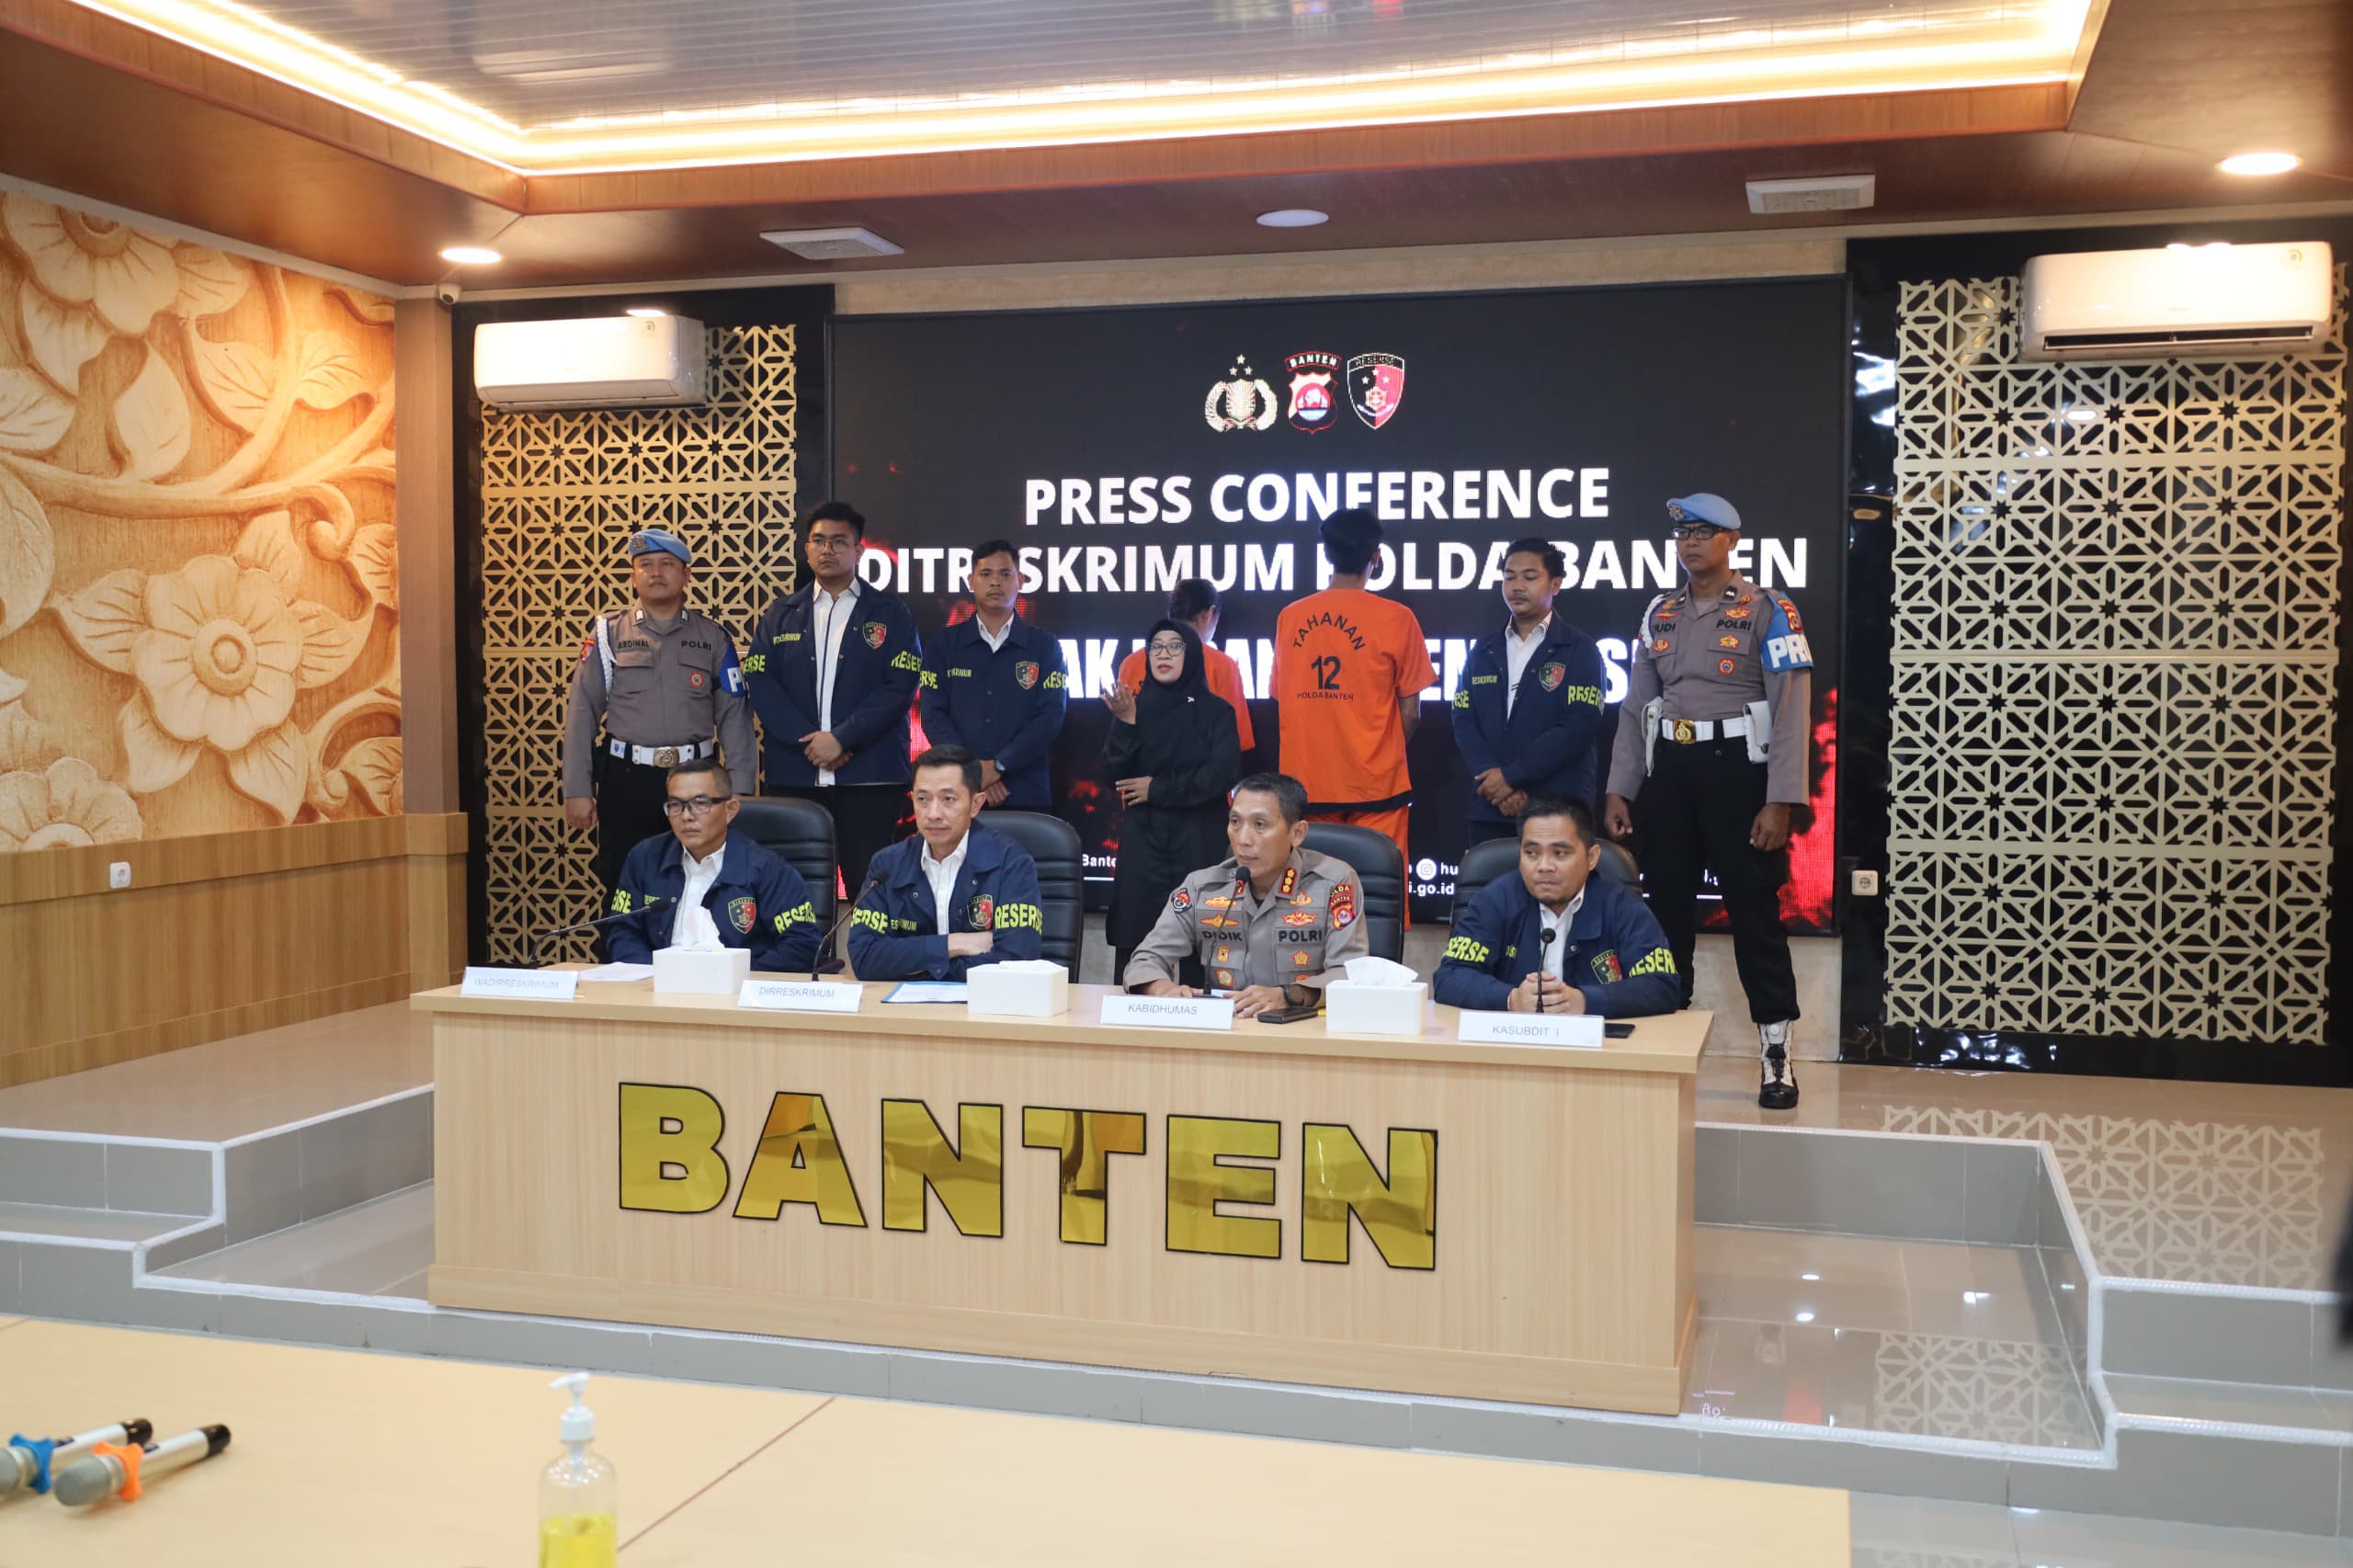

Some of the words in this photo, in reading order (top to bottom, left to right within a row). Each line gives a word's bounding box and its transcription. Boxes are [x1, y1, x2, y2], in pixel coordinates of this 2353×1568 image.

[1290, 354, 1337, 368] BANTEN
[1026, 475, 1192, 526] PRESS
[1210, 468, 1609, 524] CONFERENCE
[858, 544, 1293, 594] DITRSKRIMUM
[1548, 538, 1807, 589] BANEN
[1293, 611, 1366, 651] TAHANAN
[1716, 619, 1752, 631] POLRI
[681, 640, 711, 651] POLRI
[1311, 655, 1341, 689] 12
[1324, 692, 1353, 700] BANTEN
[1278, 930, 1323, 942] POLRI
[758, 986, 835, 998] DIRRESKRIMUM
[1128, 1004, 1198, 1016] KABIDHUMAS
[1492, 1025, 1550, 1037] KASUBDIT
[618, 1081, 1438, 1270] BANTEN
